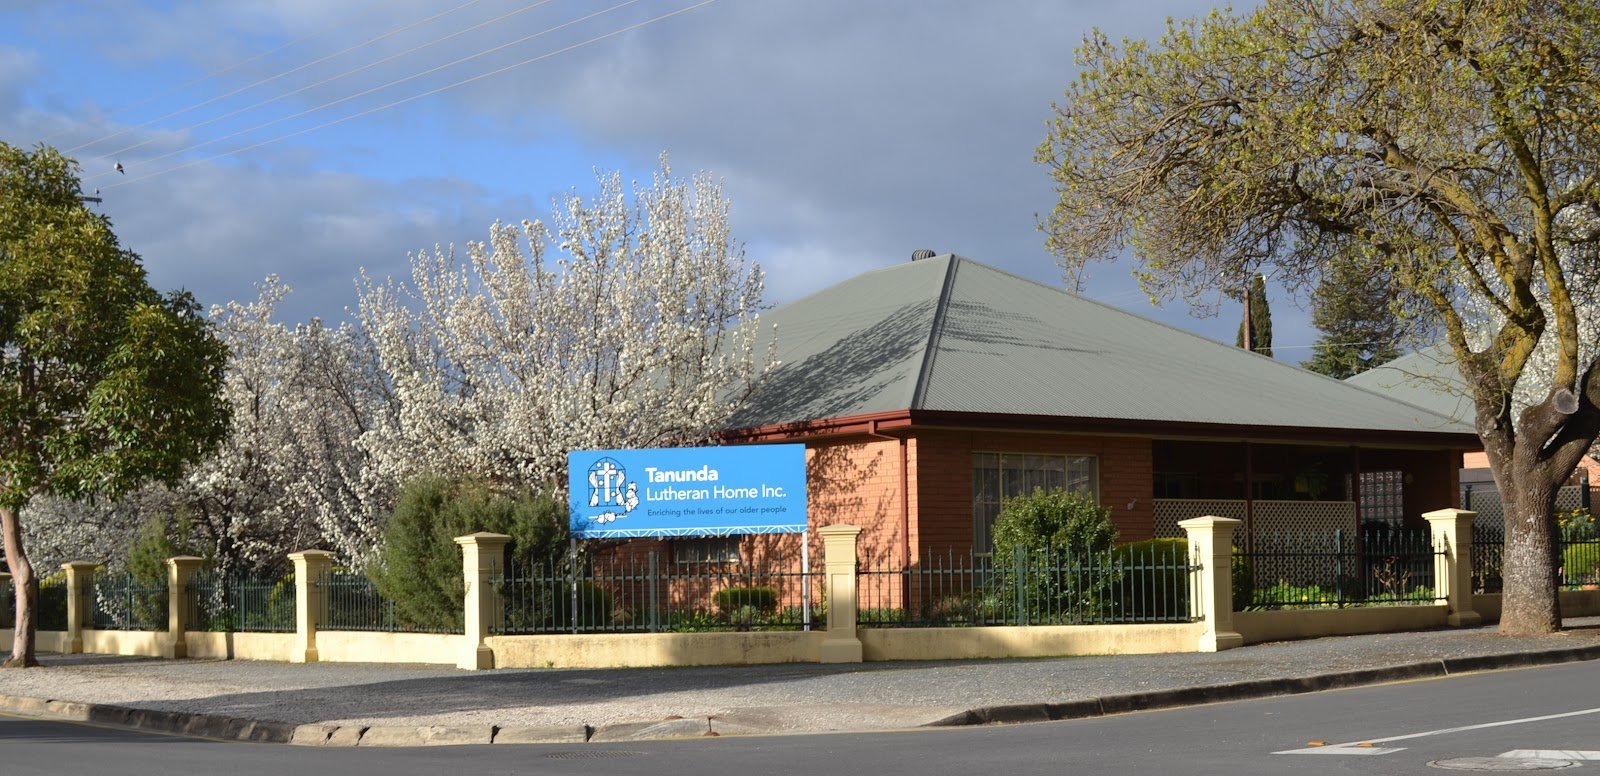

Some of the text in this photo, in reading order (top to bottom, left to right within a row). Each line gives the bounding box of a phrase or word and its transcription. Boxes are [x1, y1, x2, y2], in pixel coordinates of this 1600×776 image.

[645, 465, 718, 483] Tanunda
[646, 484, 786, 501] Lutheran Home Inc.
[647, 509, 681, 517] Enriching
[683, 508, 695, 516] the
[697, 507, 713, 516] lives
[715, 507, 723, 515] of
[740, 506, 758, 514] older
[761, 506, 787, 515] people
